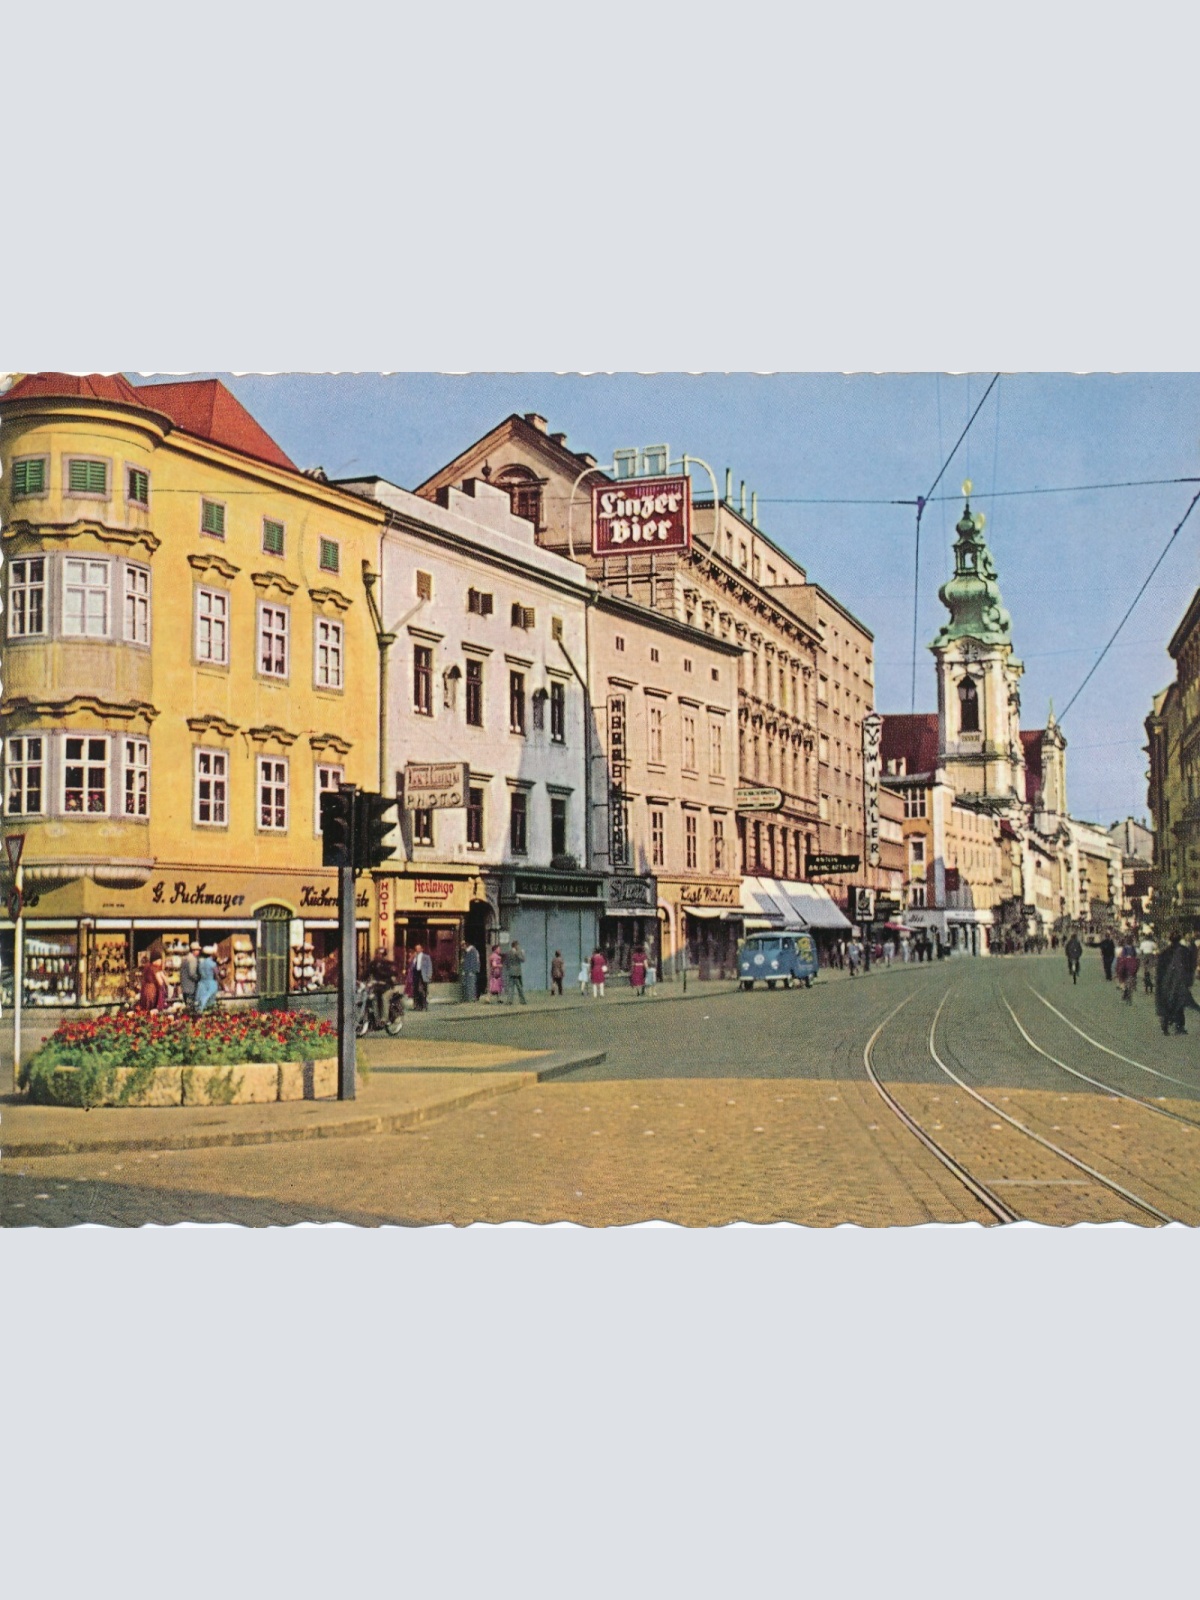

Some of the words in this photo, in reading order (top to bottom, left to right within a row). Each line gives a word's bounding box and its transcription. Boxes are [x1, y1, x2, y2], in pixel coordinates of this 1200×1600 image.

[599, 491, 682, 518] Linzer
[610, 516, 672, 543] Bier
[407, 792, 462, 806] PHOTO
[868, 752, 879, 853] WINKLER
